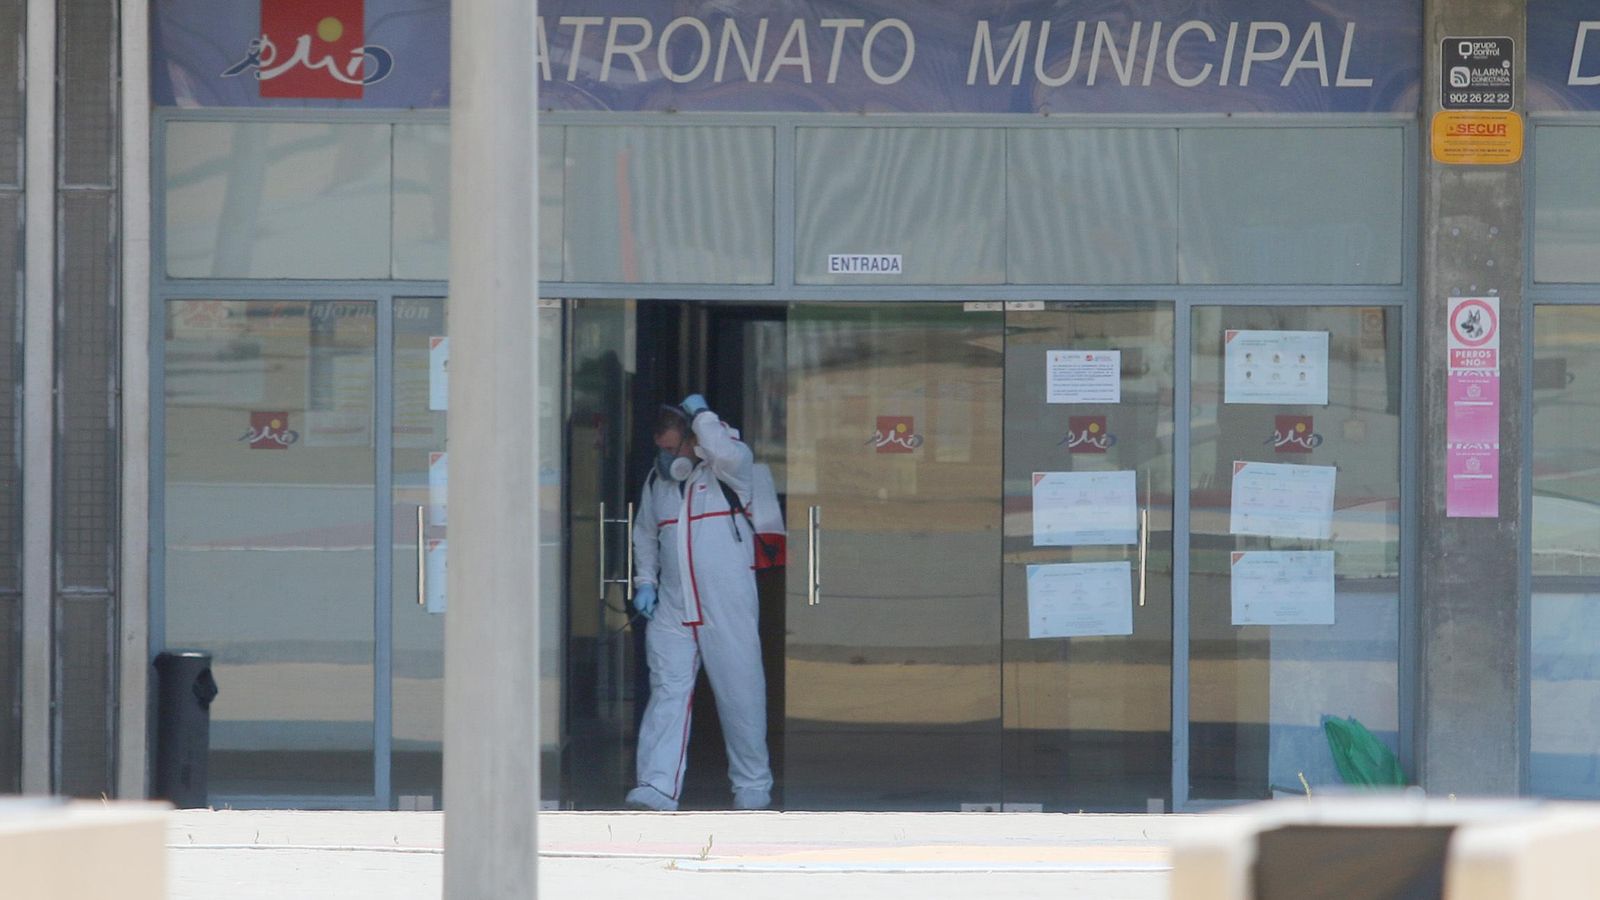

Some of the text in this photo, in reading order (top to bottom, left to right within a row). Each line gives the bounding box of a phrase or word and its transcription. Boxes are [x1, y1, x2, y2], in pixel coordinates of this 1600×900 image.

[1473, 42, 1496, 50] grupo
[966, 19, 1374, 88] MUNICIPAL
[1473, 48, 1500, 56] control
[1471, 68, 1510, 76] ALARMA
[1449, 93, 1510, 103] 902 26 22 22
[1456, 123, 1506, 135] SECUR
[831, 257, 900, 271] ENTRADA
[1455, 350, 1492, 359] PERROS
